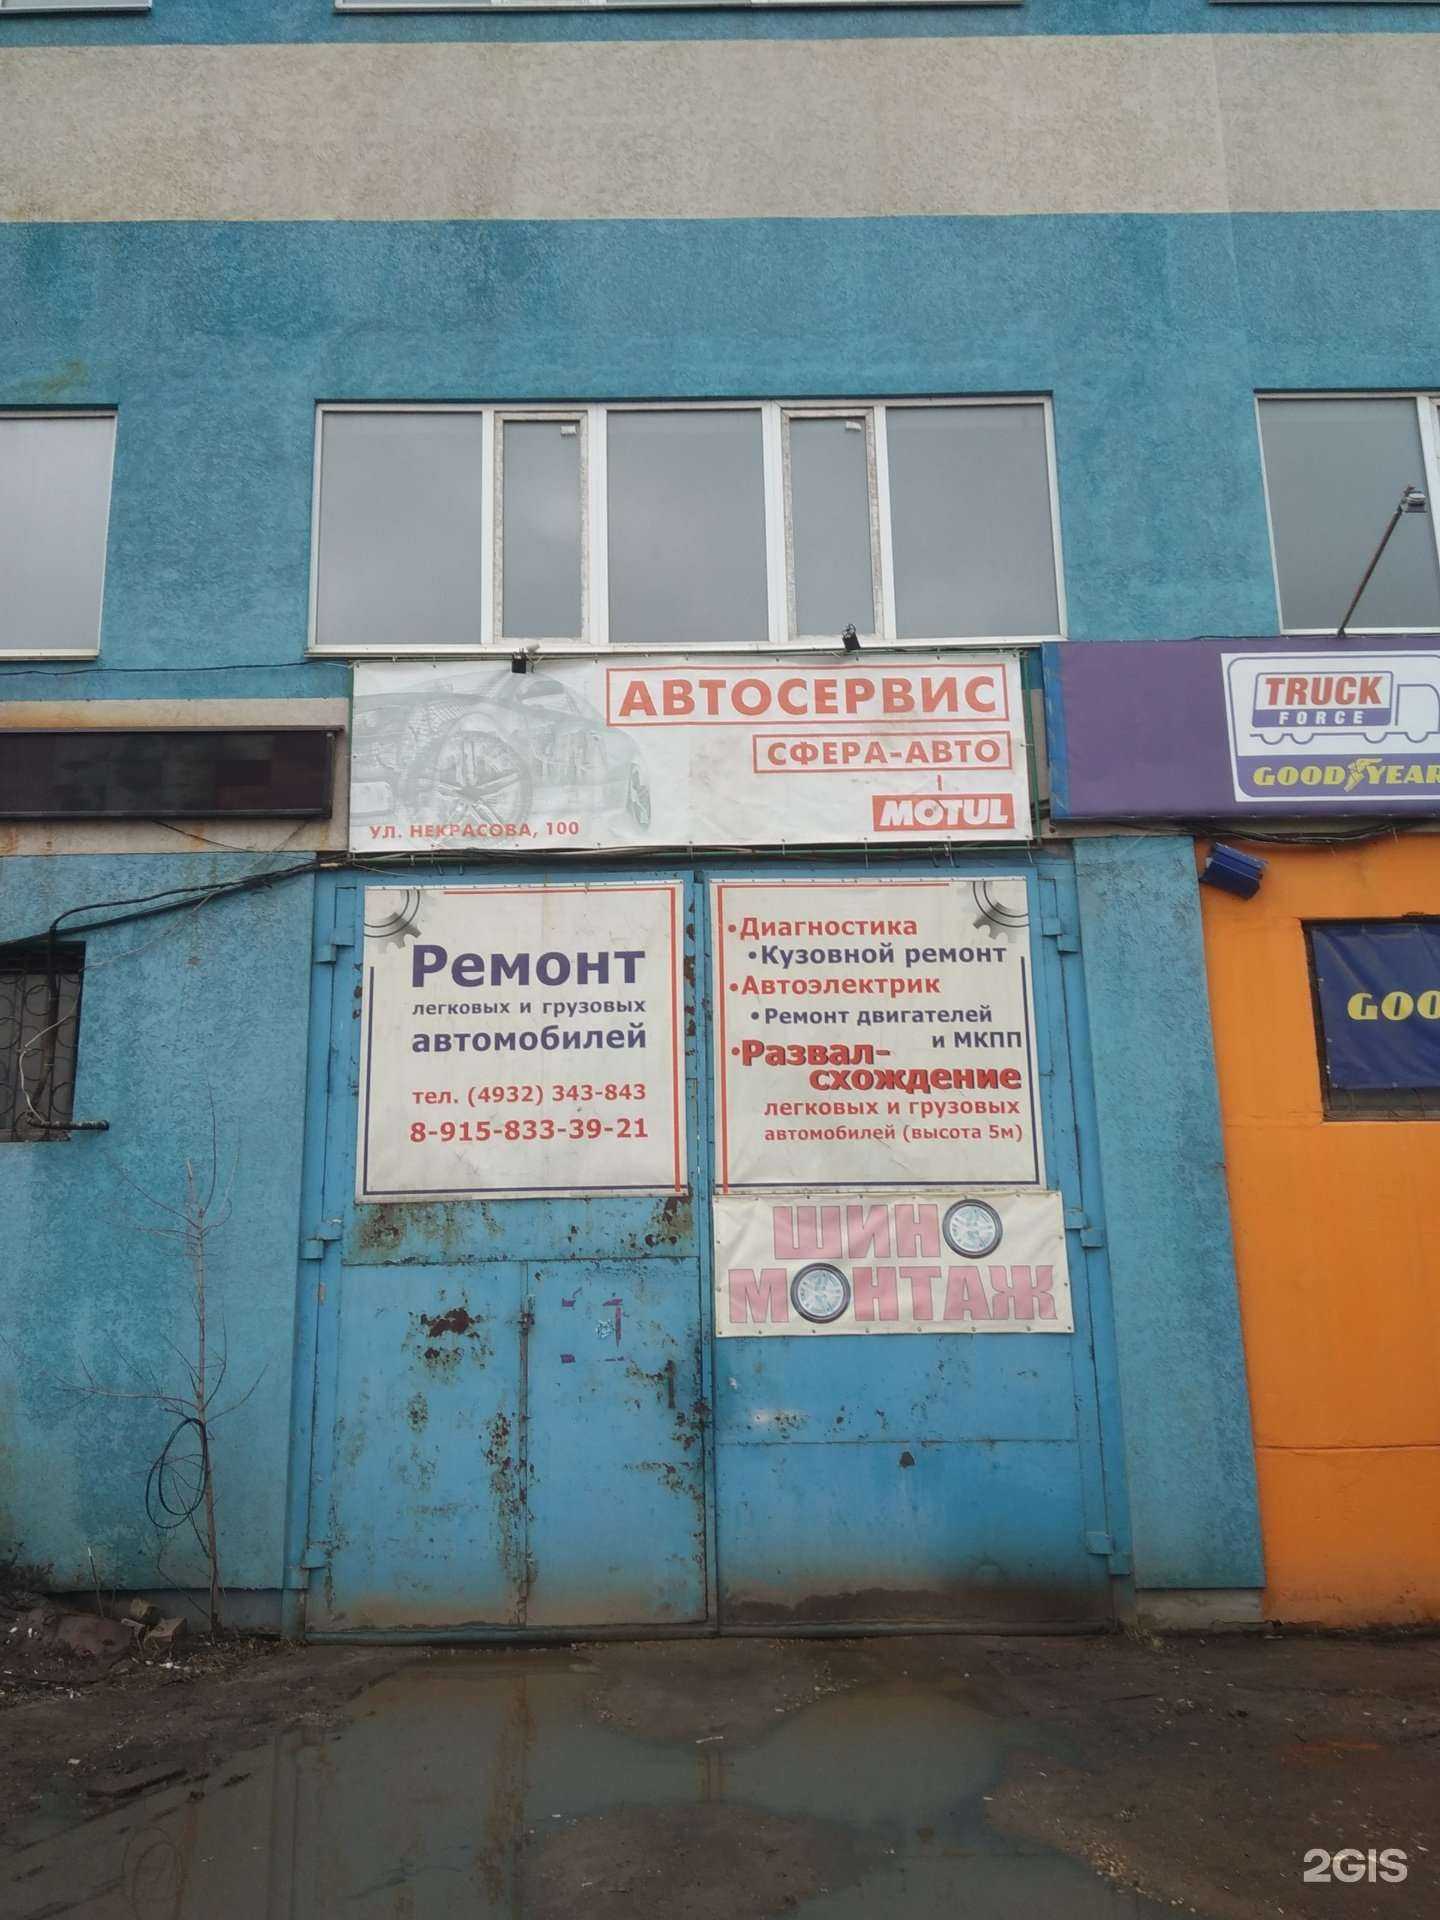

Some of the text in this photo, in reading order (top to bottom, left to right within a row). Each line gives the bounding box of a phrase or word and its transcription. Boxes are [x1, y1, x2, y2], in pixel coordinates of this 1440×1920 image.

[618, 675, 997, 717] АВТОСЕРВИС
[1265, 675, 1383, 706] TRUCK
[1278, 710, 1364, 725] FORCE
[766, 738, 1001, 766] СФЕРА-АВТО
[879, 798, 1009, 826] MOTUL
[369, 821, 580, 839] УЛ. НЕКРАСОВА, 100
[740, 916, 918, 939] Диагностика
[411, 943, 646, 987] Ремонт
[761, 941, 1007, 968] Кузовной ремонт
[742, 975, 940, 997] Автоэлектрик
[412, 998, 647, 1017] легковых и грузовых
[764, 1003, 993, 1025] Ремонт двигателей
[411, 1021, 647, 1051] автомобилей
[932, 1031, 1023, 1048] и МКПП
[741, 1038, 891, 1066] Развал-
[809, 1065, 1023, 1093] схождение
[412, 1082, 647, 1106] тел. (4932) 343-843
[764, 1099, 1021, 1117] легковых и грузовых
[409, 1117, 649, 1141] 8-915-833-39-21
[764, 1124, 1023, 1141] автомобилей (высота 5м)
[728, 1262, 1058, 1324] МОНТАЖ
